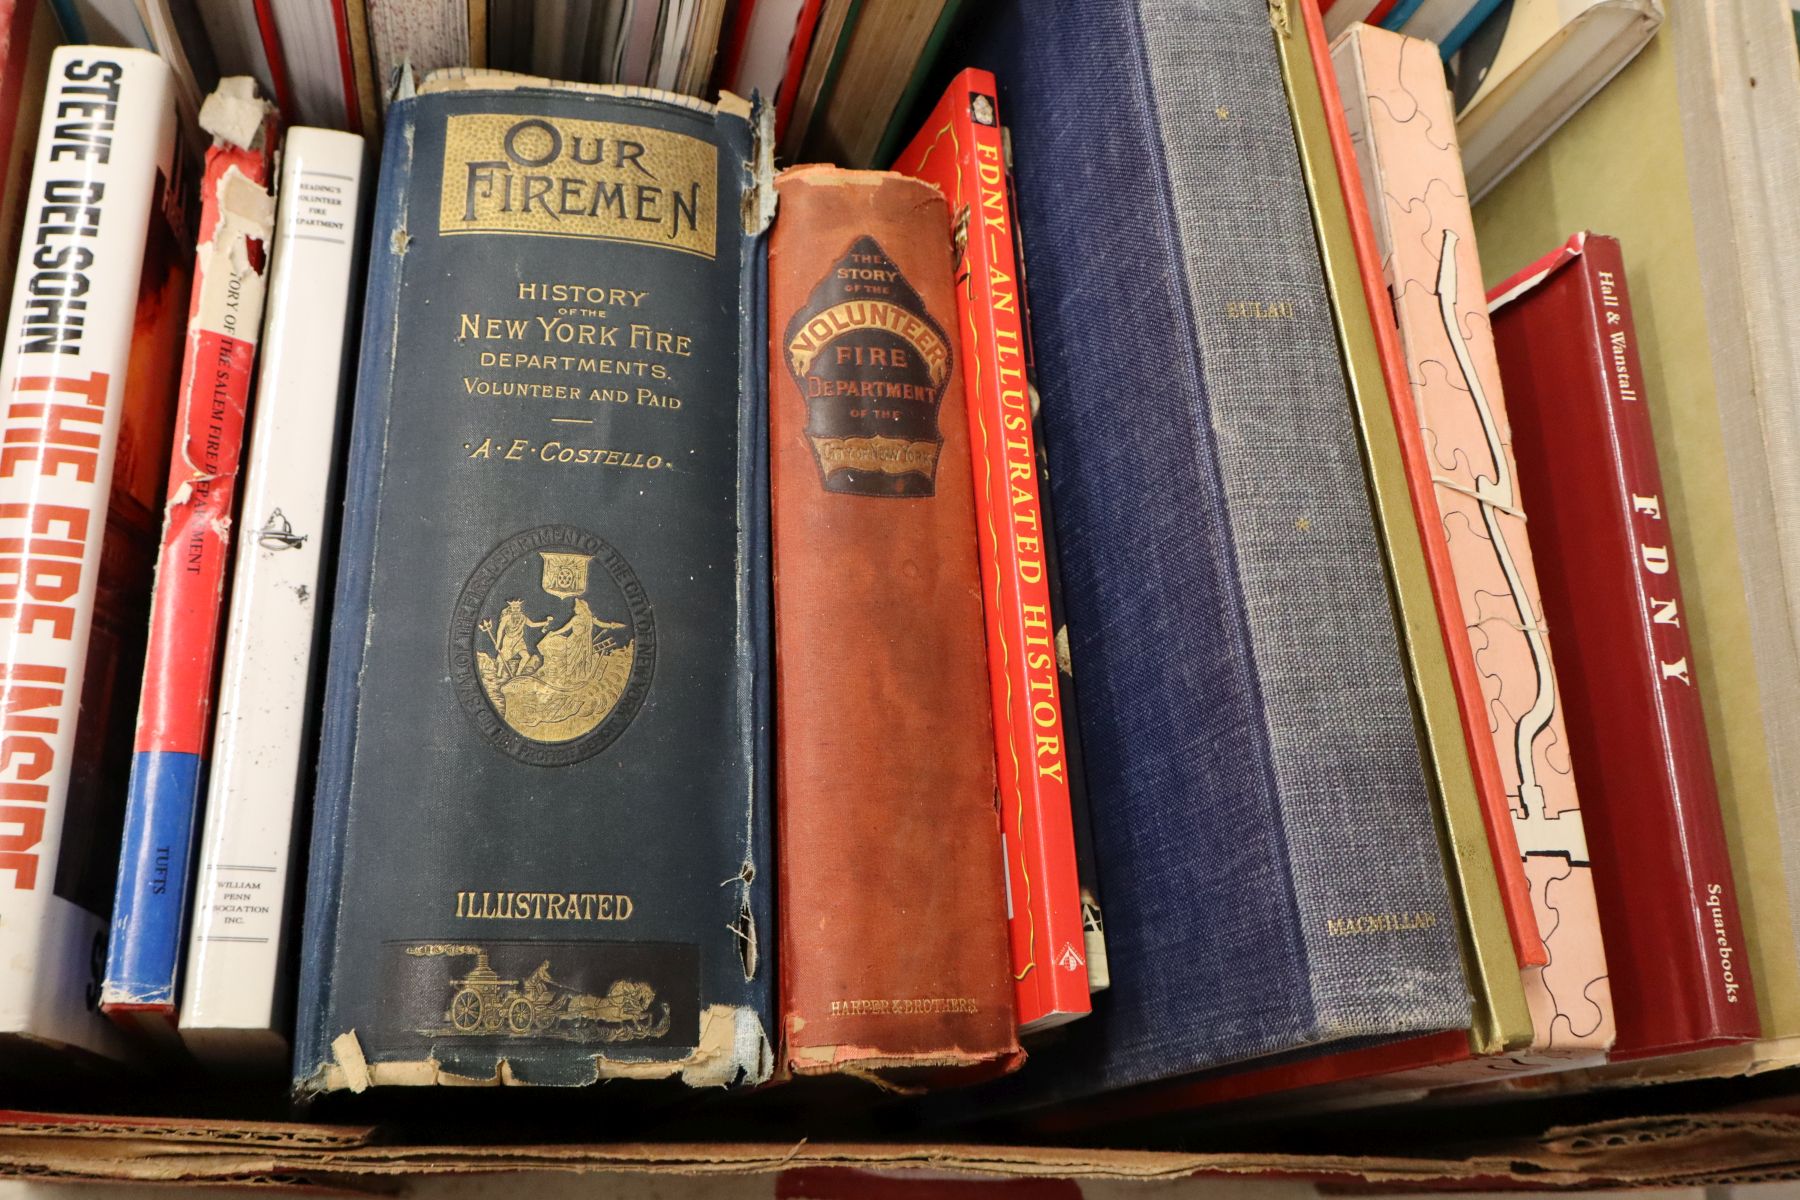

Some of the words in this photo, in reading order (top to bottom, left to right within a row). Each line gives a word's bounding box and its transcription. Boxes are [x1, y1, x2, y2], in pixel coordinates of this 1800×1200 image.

[49, 60, 123, 165] STEVE
[504, 119, 659, 181] OUR
[462, 161, 701, 239] FIREMEN
[292, 218, 344, 230] EPARTMENT
[18, 180, 105, 356] DELSOHN
[837, 268, 899, 282] STORY
[852, 254, 881, 264] THE
[518, 283, 649, 307] HISTORY
[845, 284, 864, 293] OF
[867, 285, 891, 294] THE
[1598, 271, 1619, 307] Hall
[223, 314, 237, 335] OF
[558, 307, 577, 316] OF
[580, 308, 607, 318] THE
[1606, 311, 1622, 325] &
[460, 314, 529, 340] NEW
[536, 317, 620, 347] YORK
[630, 324, 693, 357] FIRE
[792, 303, 947, 367] VOLUNTEER
[217, 337, 232, 370] THE
[837, 347, 908, 368] FIRE
[1610, 331, 1637, 401] Wanstall
[209, 371, 230, 421] SALEM
[463, 377, 581, 400] VOLUNTEER
[589, 389, 629, 403] AND
[636, 388, 682, 409] PAID
[807, 376, 938, 404] DEPARTMENT
[0, 371, 110, 484] THE
[850, 409, 871, 419] OF
[873, 410, 901, 420] THE
[203, 422, 222, 465] FIRE
[187, 465, 219, 575] DEPARMENT
[995, 329, 1043, 584] ILLUSTRATED
[1023, 603, 1063, 784] HISTORY
[1632, 493, 1690, 687] FDNY
[152, 846, 170, 895] TUFTS
[217, 882, 261, 890] WILLIAM
[202, 905, 270, 914] SOCIATION
[224, 893, 252, 901] PENN
[456, 891, 634, 921] ILLUSTRATED
[1706, 884, 1740, 1004] Squarebooks
[832, 1000, 891, 1016] HARPER
[892, 1000, 903, 1014] &
[905, 998, 978, 1014] BROTHERS
